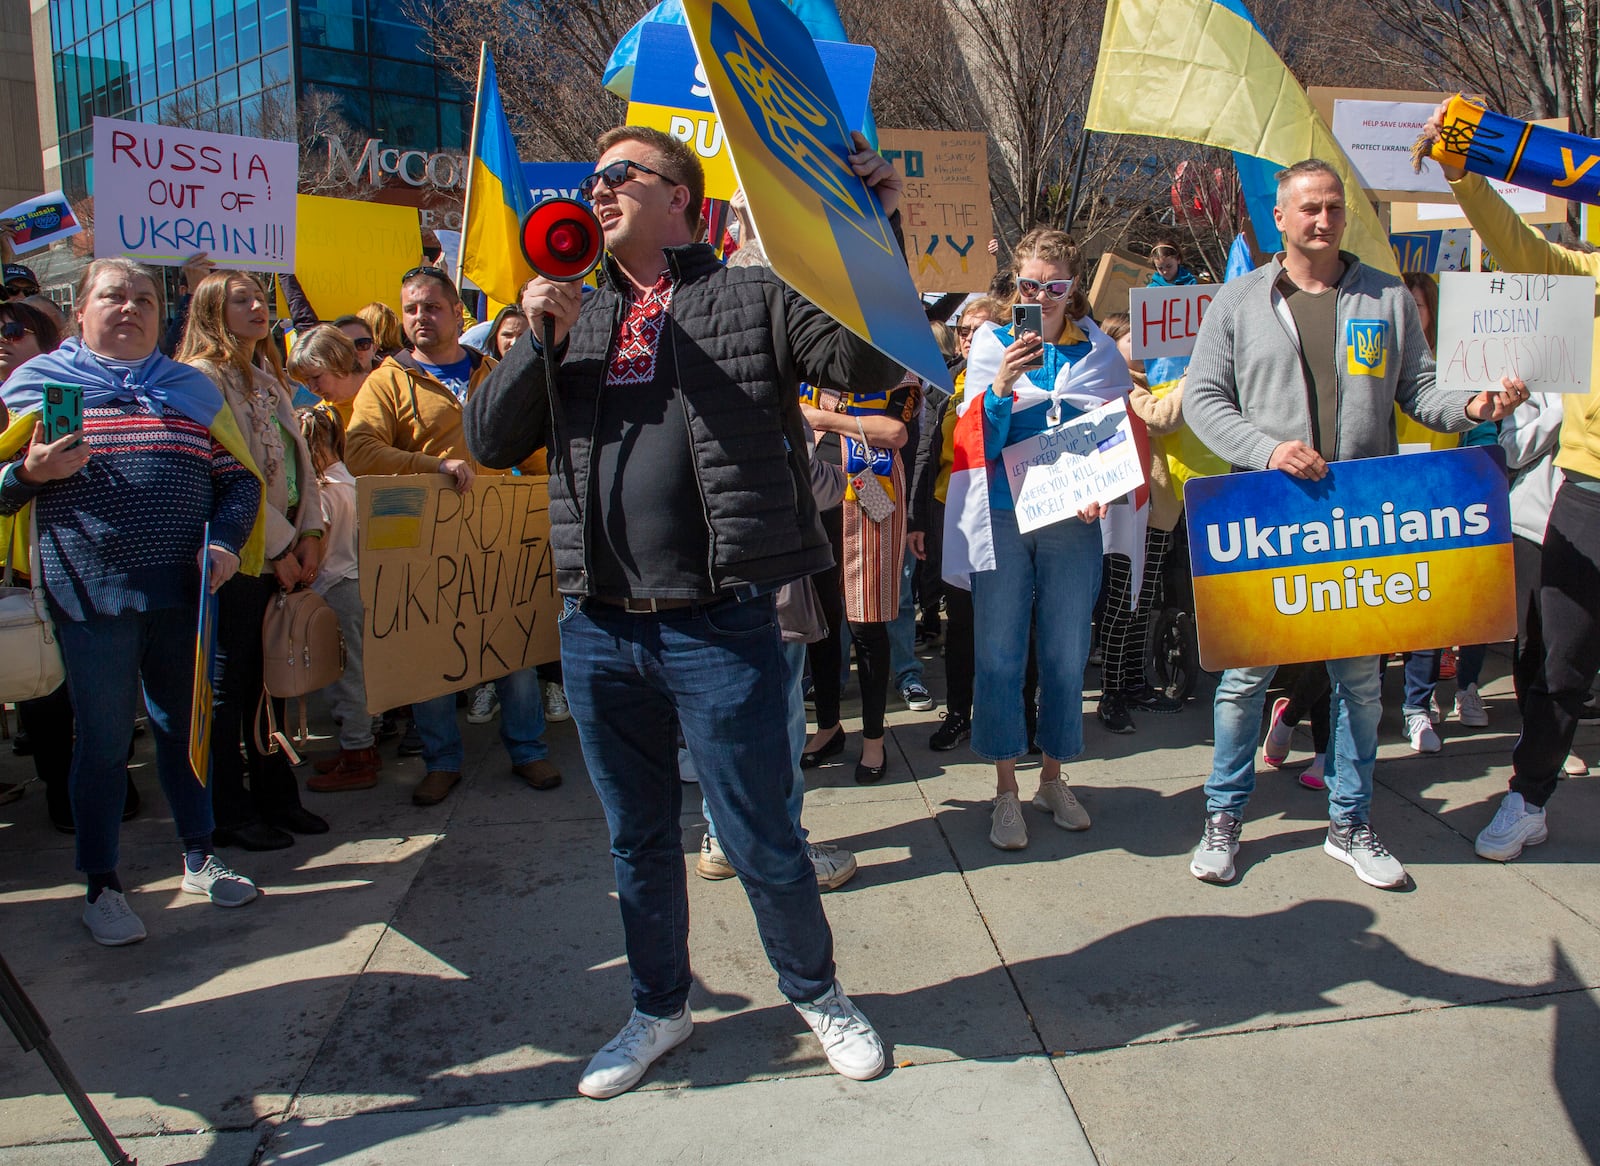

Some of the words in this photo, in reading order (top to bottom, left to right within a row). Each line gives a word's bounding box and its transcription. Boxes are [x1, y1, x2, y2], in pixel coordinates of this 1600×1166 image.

[669, 115, 724, 158] PU
[1362, 119, 1379, 127] HELP
[1380, 120, 1397, 128] SAVE
[112, 130, 269, 182] RUSSIA
[1351, 143, 1381, 151] PROTECT
[882, 150, 925, 178] TO
[148, 179, 205, 209] OUT
[221, 191, 256, 213] OF
[529, 188, 580, 204] ray
[27, 206, 56, 219] Russia
[934, 203, 977, 226] THE
[1472, 306, 1539, 334] RUSSIAN
[1066, 438, 1079, 451] UP
[1084, 431, 1097, 444] TO
[1048, 463, 1062, 476] THE
[1049, 475, 1069, 492] YOU
[1073, 463, 1098, 481] KILL
[430, 482, 549, 556] PROTE
[1021, 493, 1066, 523] YOURSELF
[1073, 488, 1082, 502] IN
[1086, 486, 1093, 497] A
[1206, 501, 1491, 563] Ukrainians
[372, 541, 555, 639] UKRAINIA
[1271, 561, 1432, 616] Unite!
[443, 609, 537, 682] SKY
